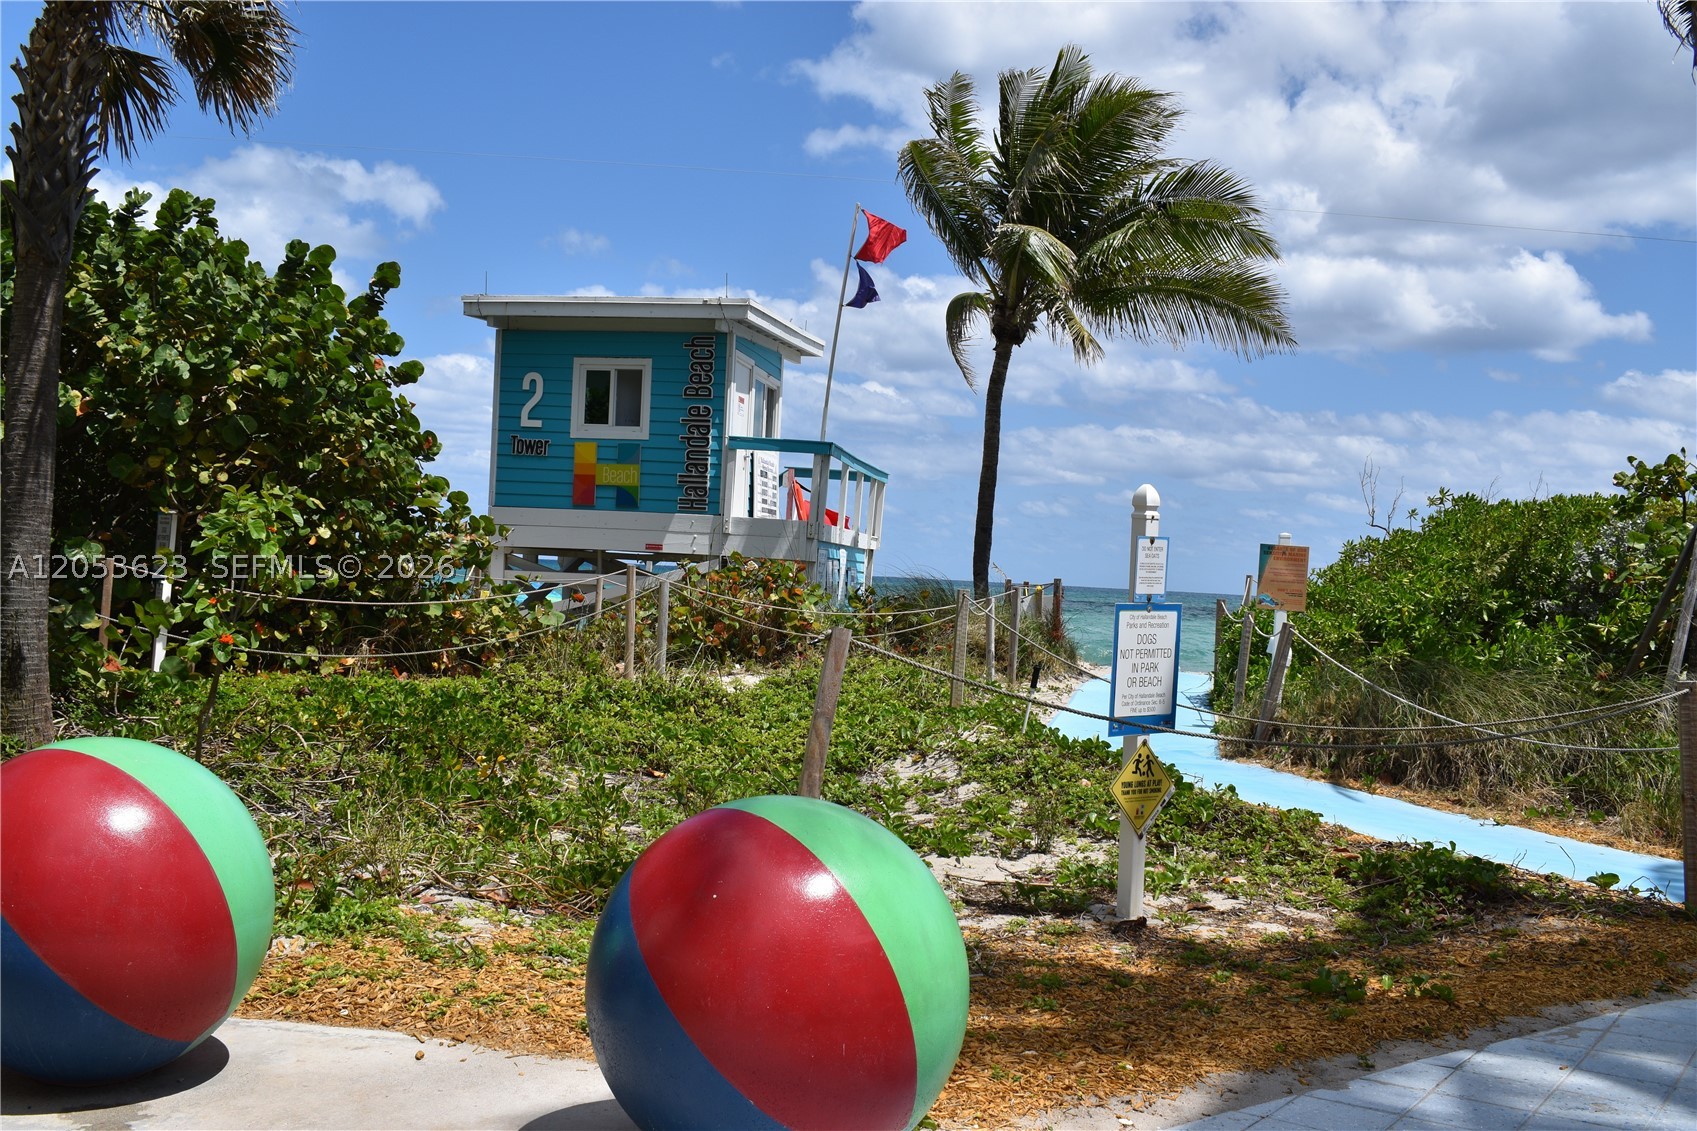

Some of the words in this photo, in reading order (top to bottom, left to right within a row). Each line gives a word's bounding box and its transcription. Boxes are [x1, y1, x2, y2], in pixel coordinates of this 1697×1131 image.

[683, 335, 716, 399] Beach
[520, 371, 544, 428] 2
[510, 434, 551, 457] Tower
[677, 405, 713, 512] Hallandale
[602, 466, 638, 483] Beach
[1148, 621, 1169, 629] Recreation
[1136, 633, 1157, 645] DOGS
[1120, 649, 1135, 660] NOT
[1135, 648, 1172, 659] PERMITTED
[1131, 662, 1139, 673] IN
[1140, 662, 1159, 673] PARK
[1127, 677, 1137, 688] OR
[1138, 676, 1162, 688] BEACH
[1121, 781, 1133, 789] YOUNG
[1134, 780, 1146, 788] LUNGS
